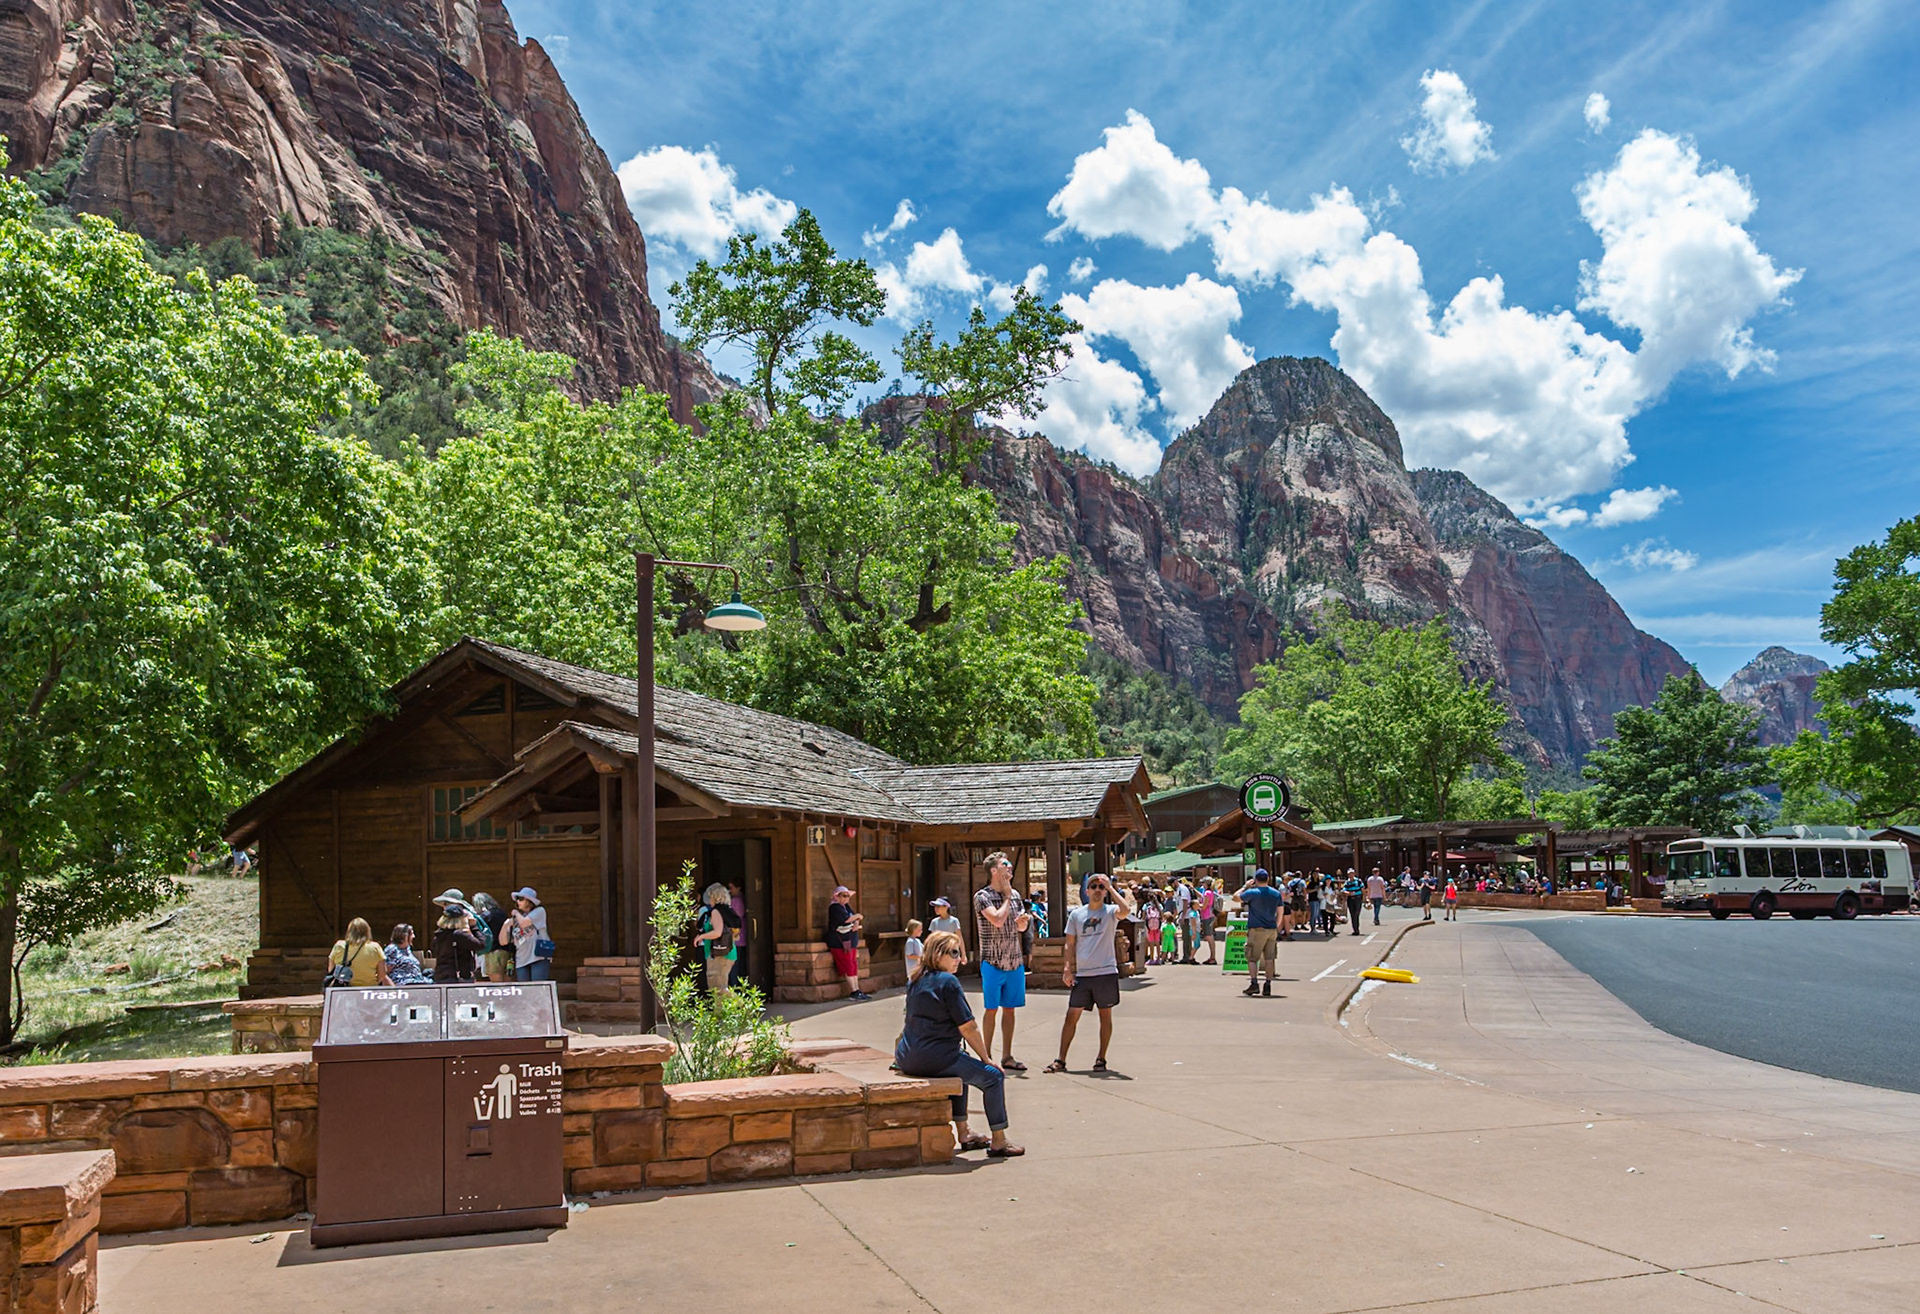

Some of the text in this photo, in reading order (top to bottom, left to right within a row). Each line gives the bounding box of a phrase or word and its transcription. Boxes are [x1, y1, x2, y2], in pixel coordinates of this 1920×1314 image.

[1245, 775, 1282, 788] ZION SHUTTLE
[1243, 805, 1287, 822] ZION CANYON LINE
[1263, 832, 1270, 844] 5
[1780, 878, 1817, 892] Zion
[360, 989, 409, 1000] Trash
[475, 986, 522, 998] Trash
[519, 1062, 562, 1077] Trash
